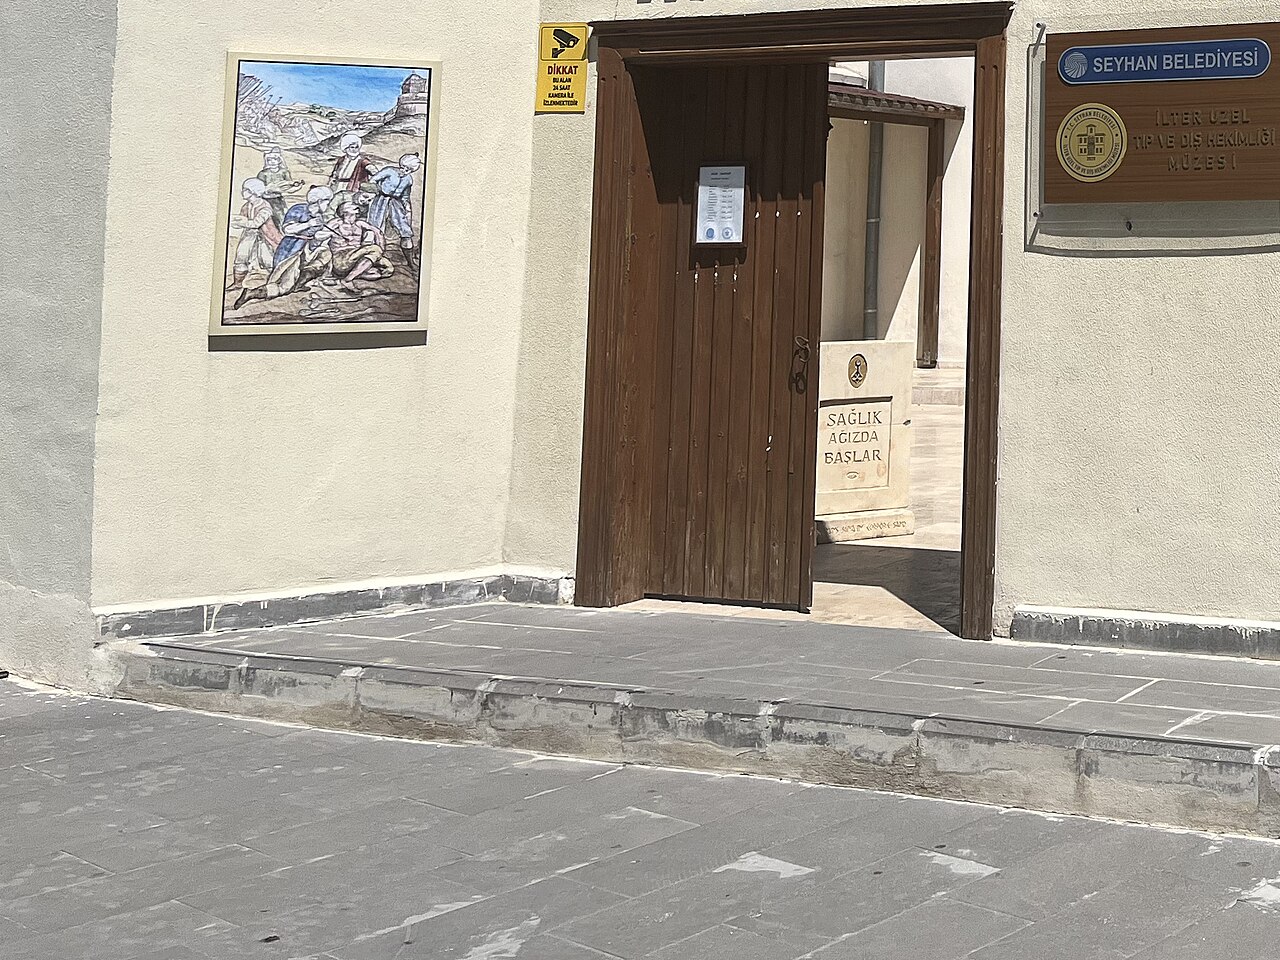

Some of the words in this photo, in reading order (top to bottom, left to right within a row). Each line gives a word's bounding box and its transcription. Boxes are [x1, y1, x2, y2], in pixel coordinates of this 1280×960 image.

[1093, 54, 1158, 73] SEYHAN
[1162, 47, 1259, 70] BELEDİYESİ
[547, 63, 578, 75] DİKKAT
[826, 408, 883, 427] SAĞLIK
[828, 429, 879, 445] AĞIZDA
[824, 449, 882, 465] BAŞLAR
